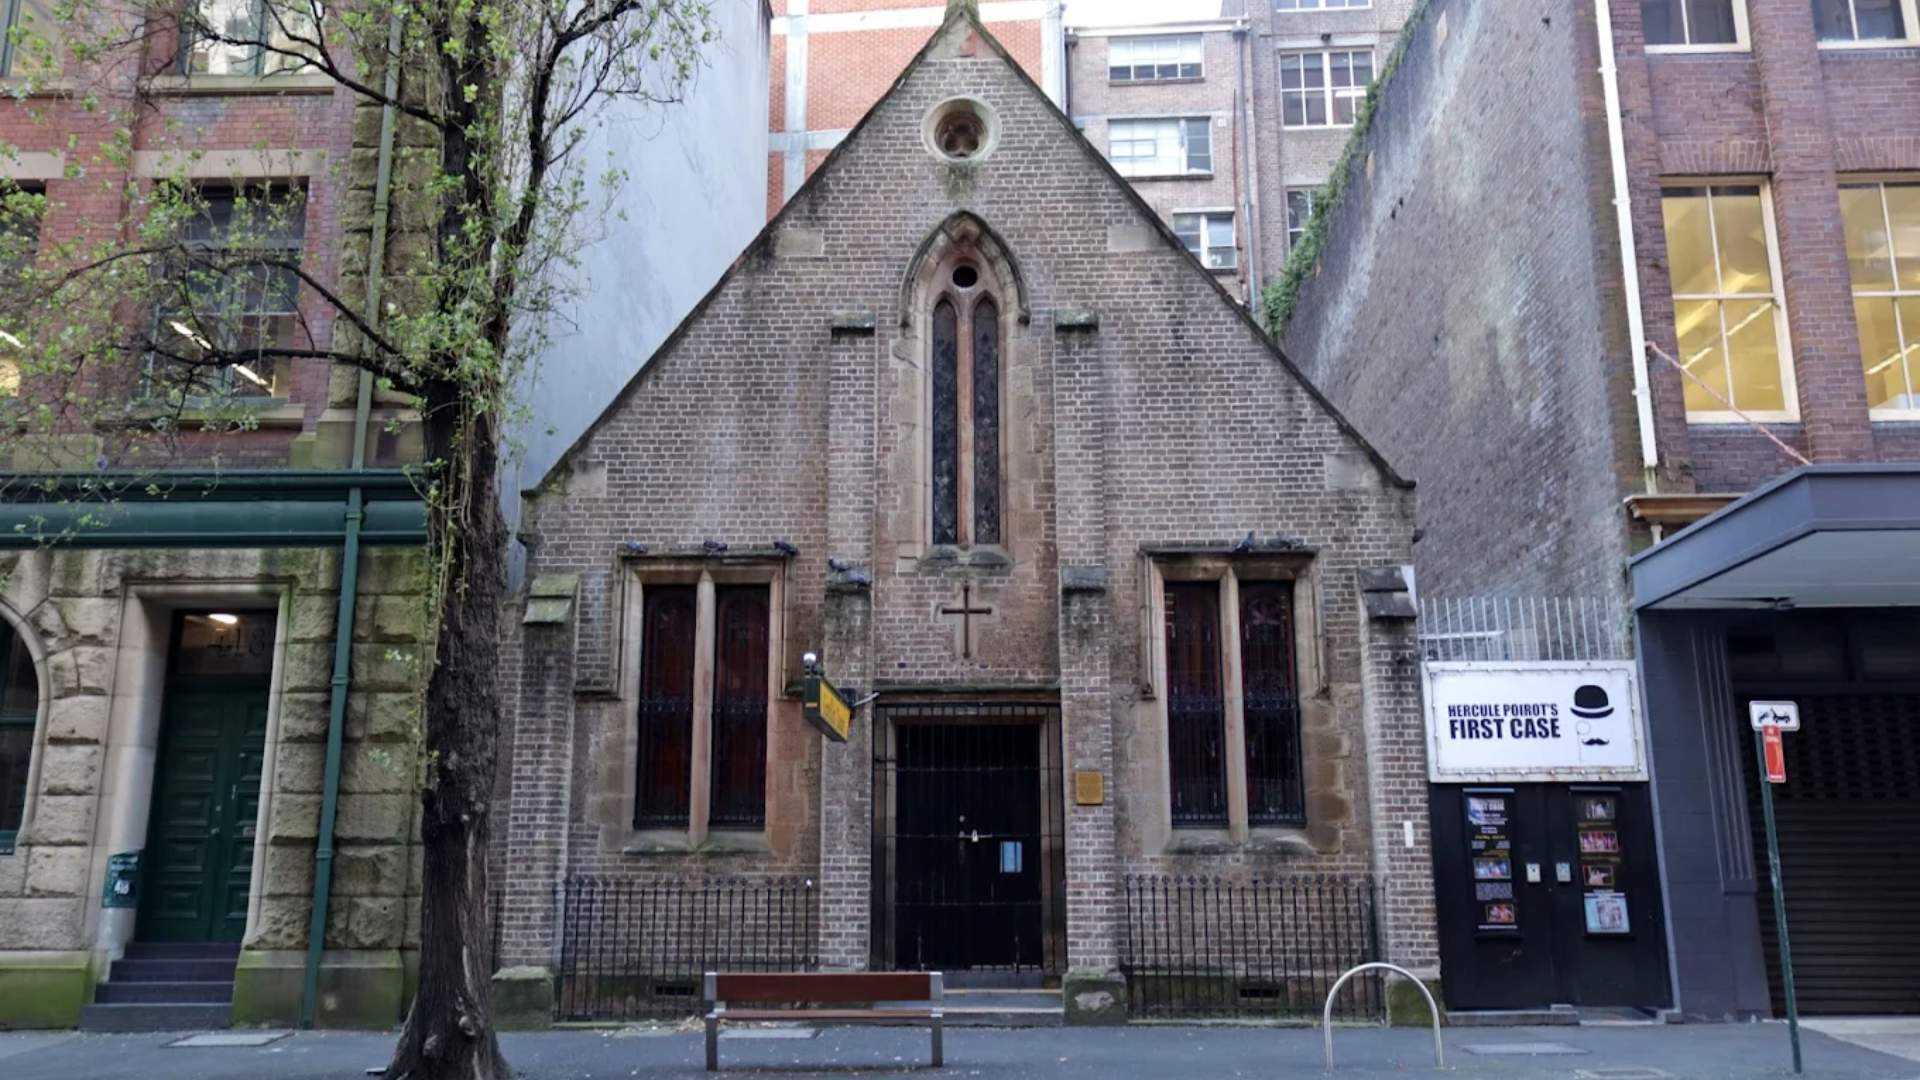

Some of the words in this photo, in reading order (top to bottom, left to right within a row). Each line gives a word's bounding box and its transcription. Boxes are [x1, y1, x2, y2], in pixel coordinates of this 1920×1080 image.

[1448, 704, 1501, 717] HERCULE
[1503, 703, 1559, 717] POIROT'S
[1449, 719, 1504, 739] FIRST
[1510, 718, 1561, 739] CASE
